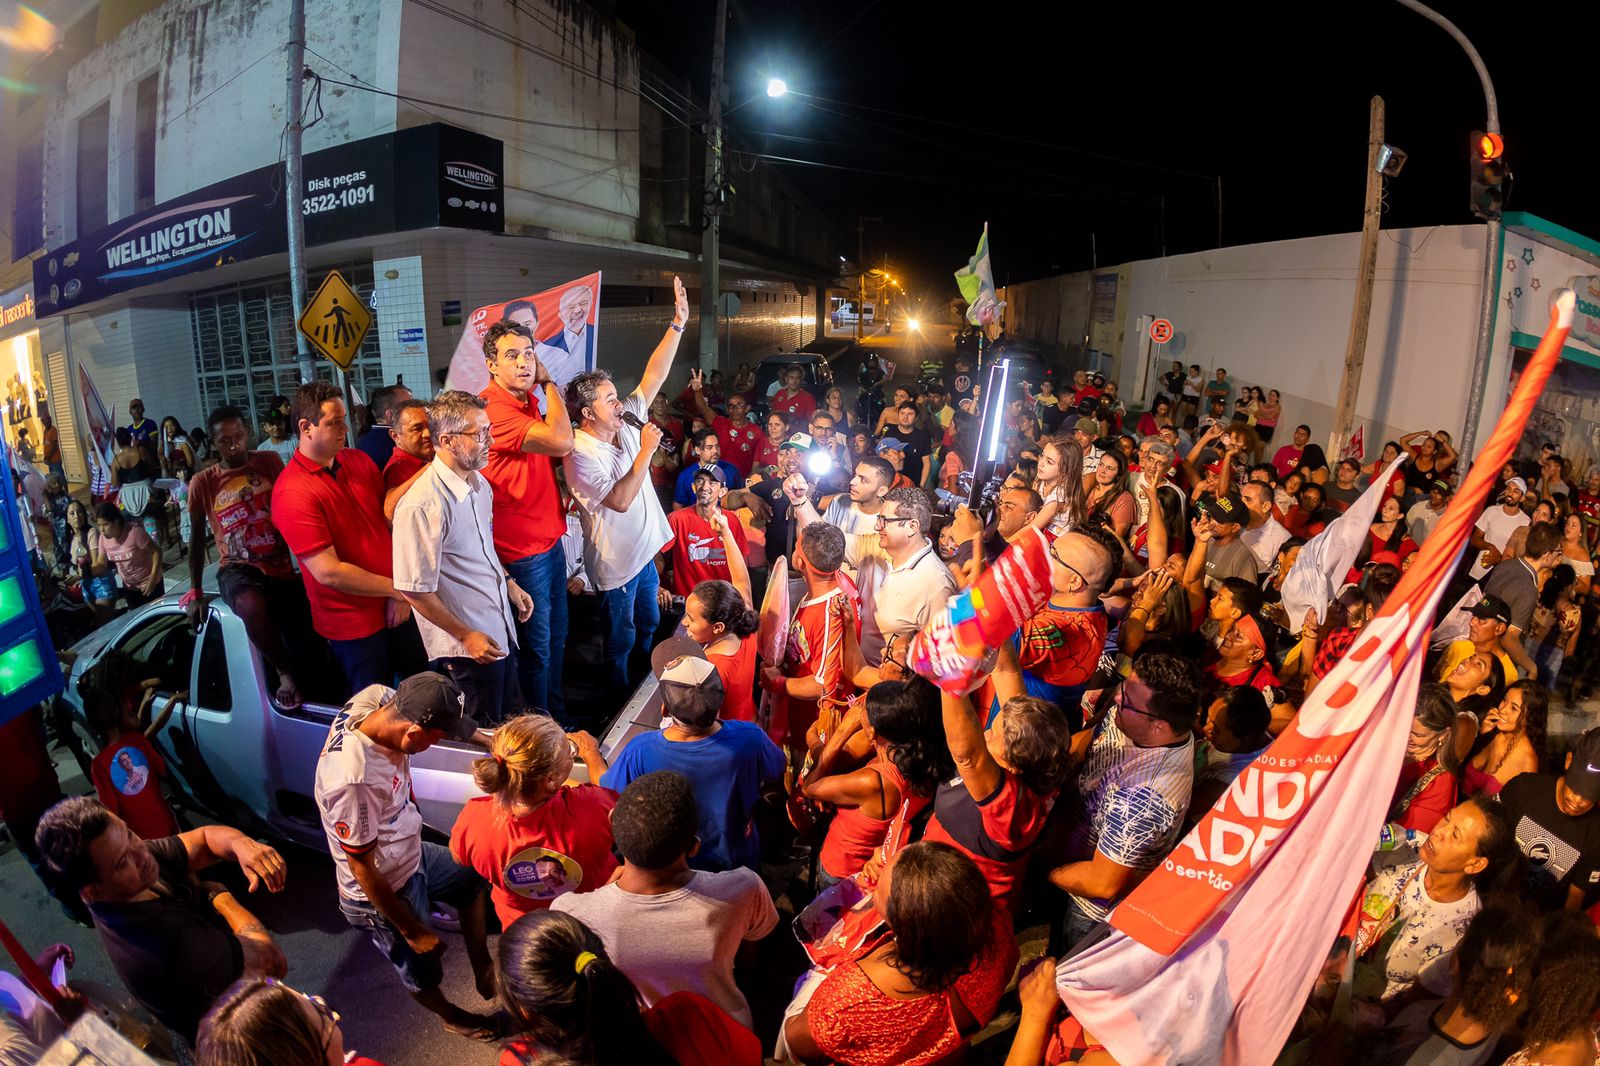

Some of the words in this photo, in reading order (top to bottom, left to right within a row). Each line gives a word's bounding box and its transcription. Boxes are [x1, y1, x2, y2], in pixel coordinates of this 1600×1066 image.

[308, 177, 331, 192] Disk
[333, 170, 367, 188] peças
[446, 165, 495, 184] WELLINGTON
[302, 184, 375, 215] 3522-1091
[106, 208, 231, 269] WELLINGTON
[511, 865, 533, 875] LEO
[1176, 864, 1234, 892] sertão
